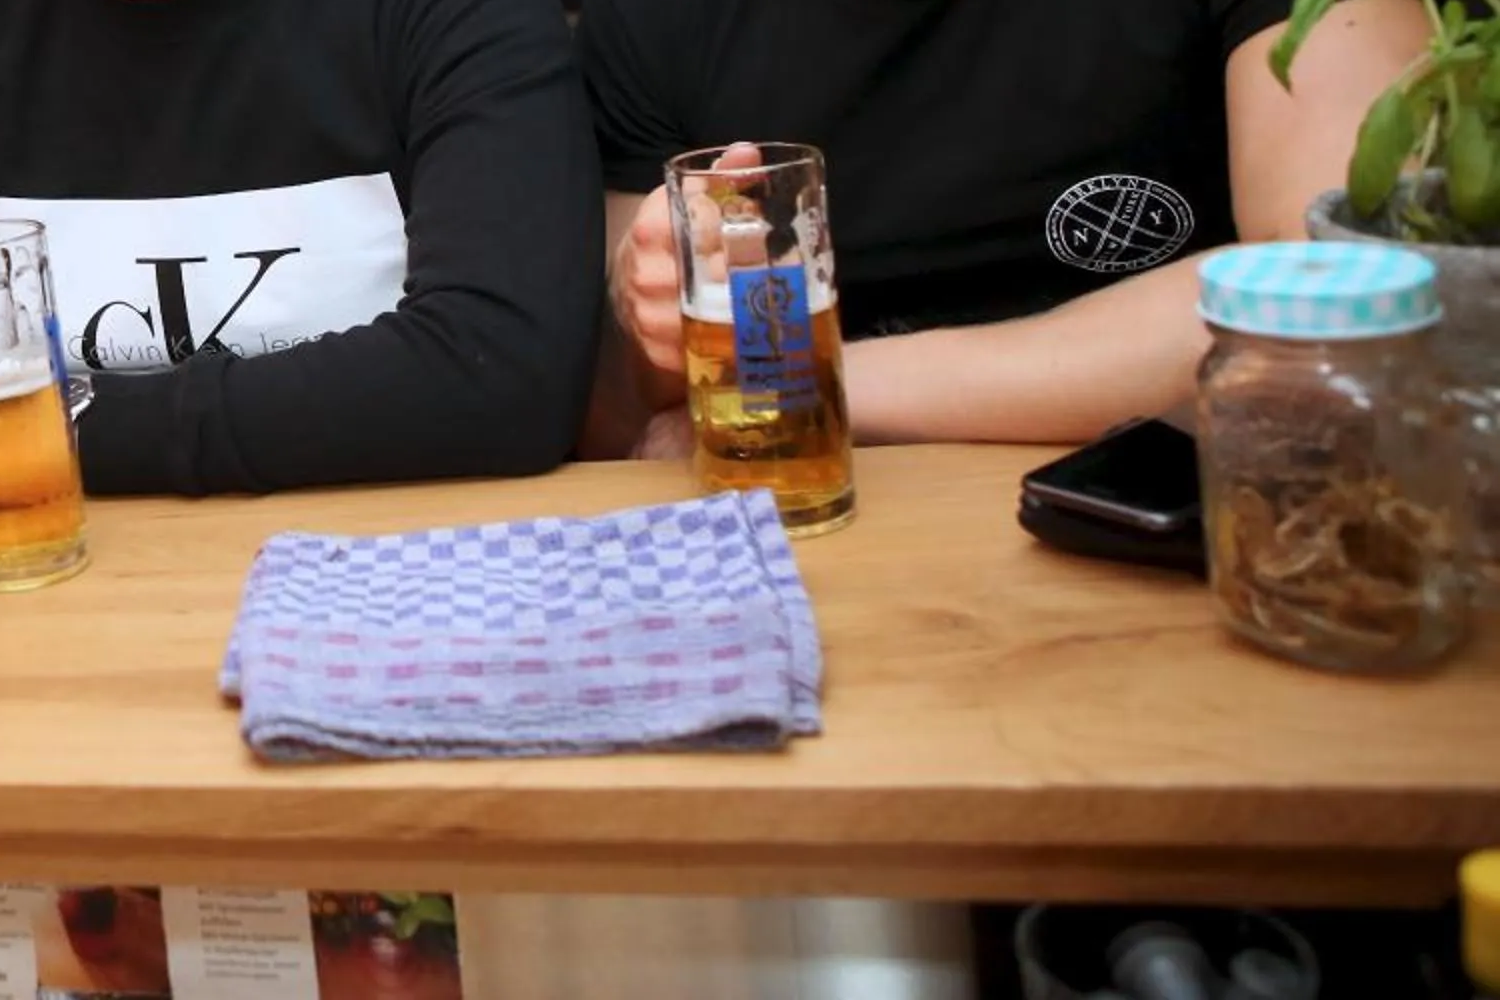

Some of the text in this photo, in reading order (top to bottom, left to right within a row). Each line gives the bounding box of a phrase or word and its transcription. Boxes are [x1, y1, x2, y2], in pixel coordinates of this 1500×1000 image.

[1150, 208, 1163, 226] Y
[1072, 227, 1089, 247] N
[67, 335, 164, 362] Calvin
